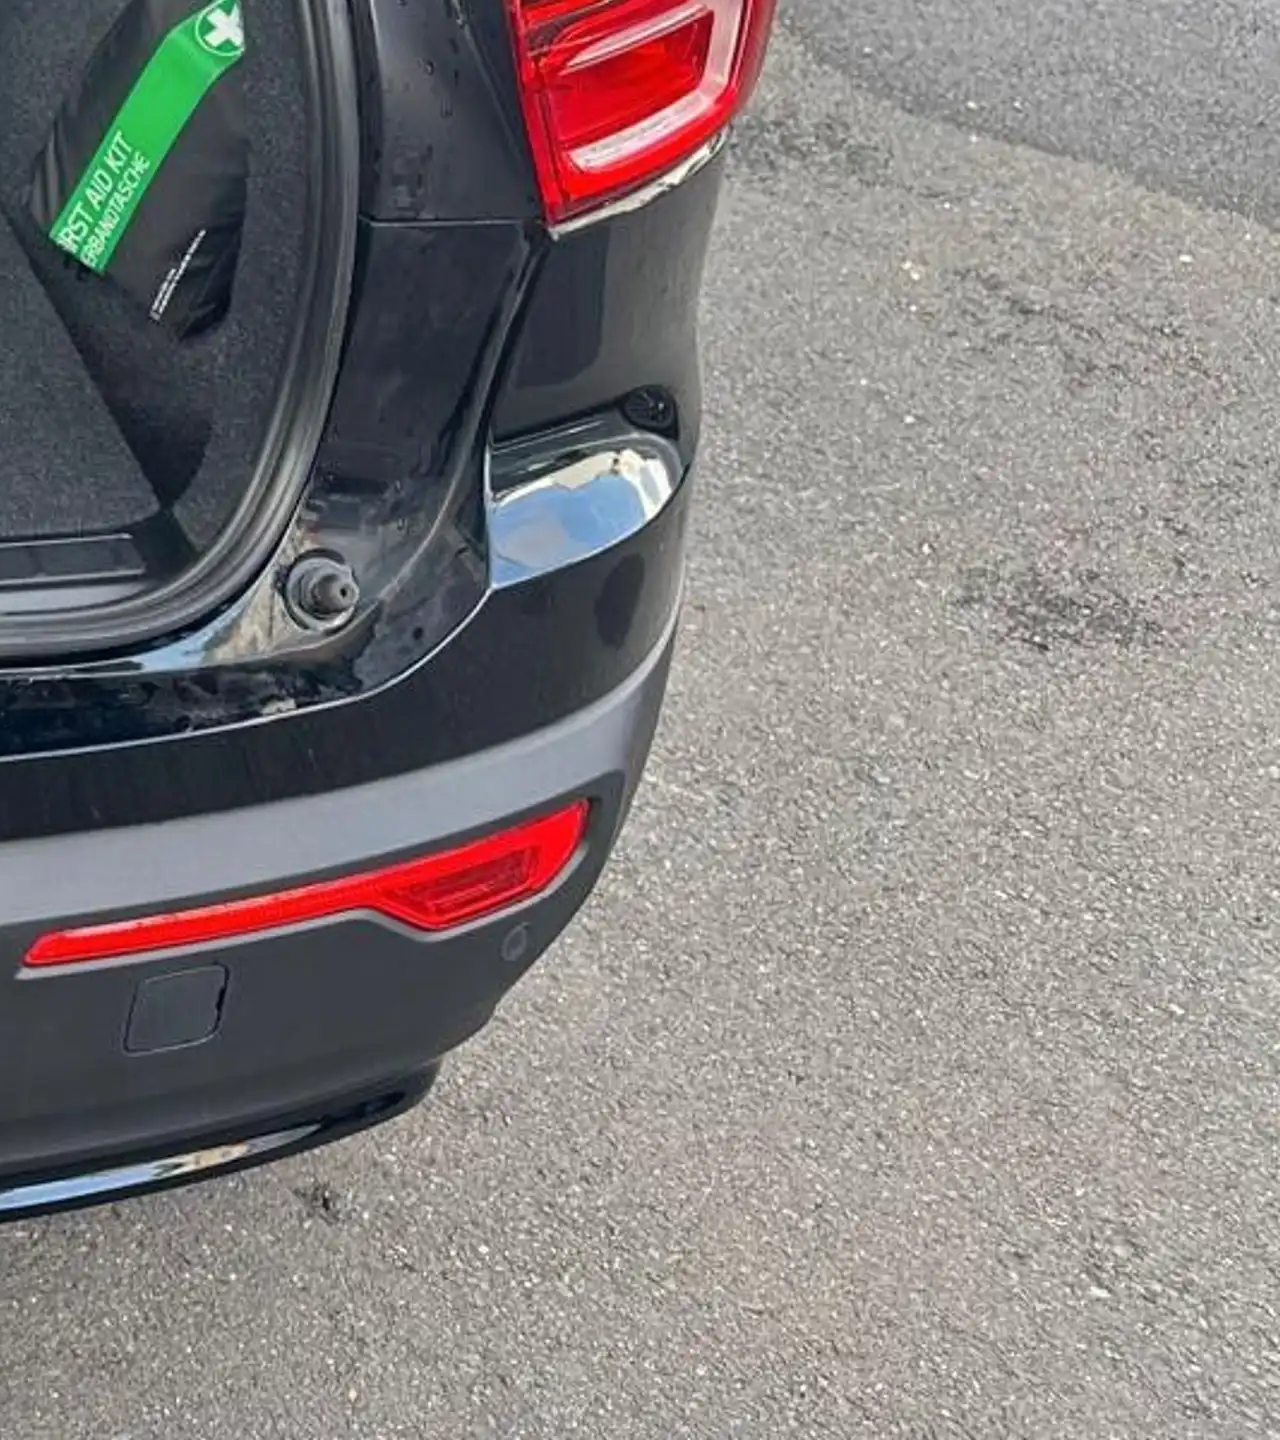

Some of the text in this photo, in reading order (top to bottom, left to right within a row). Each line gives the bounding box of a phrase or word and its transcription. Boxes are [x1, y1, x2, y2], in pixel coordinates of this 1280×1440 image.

[80, 151, 150, 268] ERBANDTASCHE
[85, 168, 113, 211] AID
[104, 129, 133, 174] KIT
